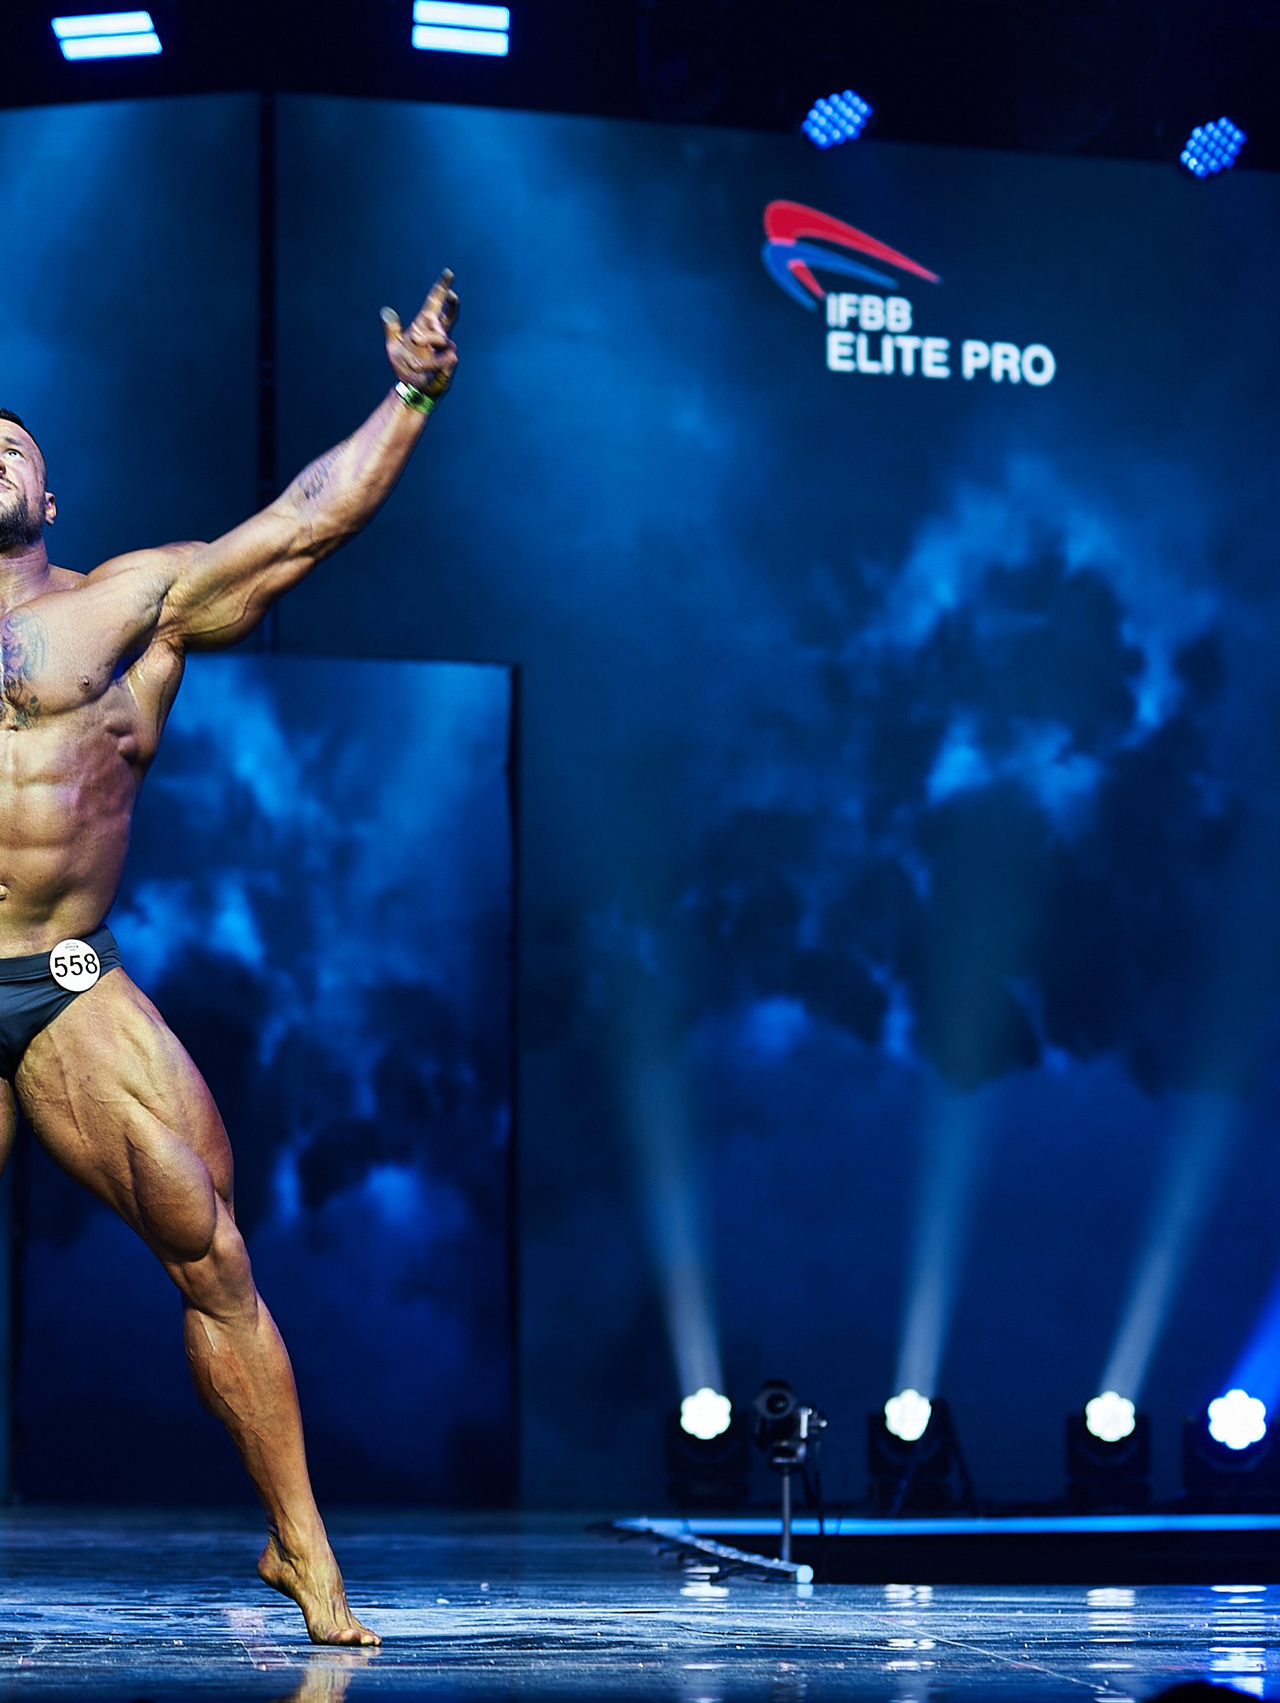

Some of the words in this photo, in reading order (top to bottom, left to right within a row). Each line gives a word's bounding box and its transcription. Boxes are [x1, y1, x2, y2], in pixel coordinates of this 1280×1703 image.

[826, 292, 912, 333] IFBB
[826, 330, 951, 379] ELITE
[961, 339, 1057, 386] PRO
[54, 953, 98, 978] 558
